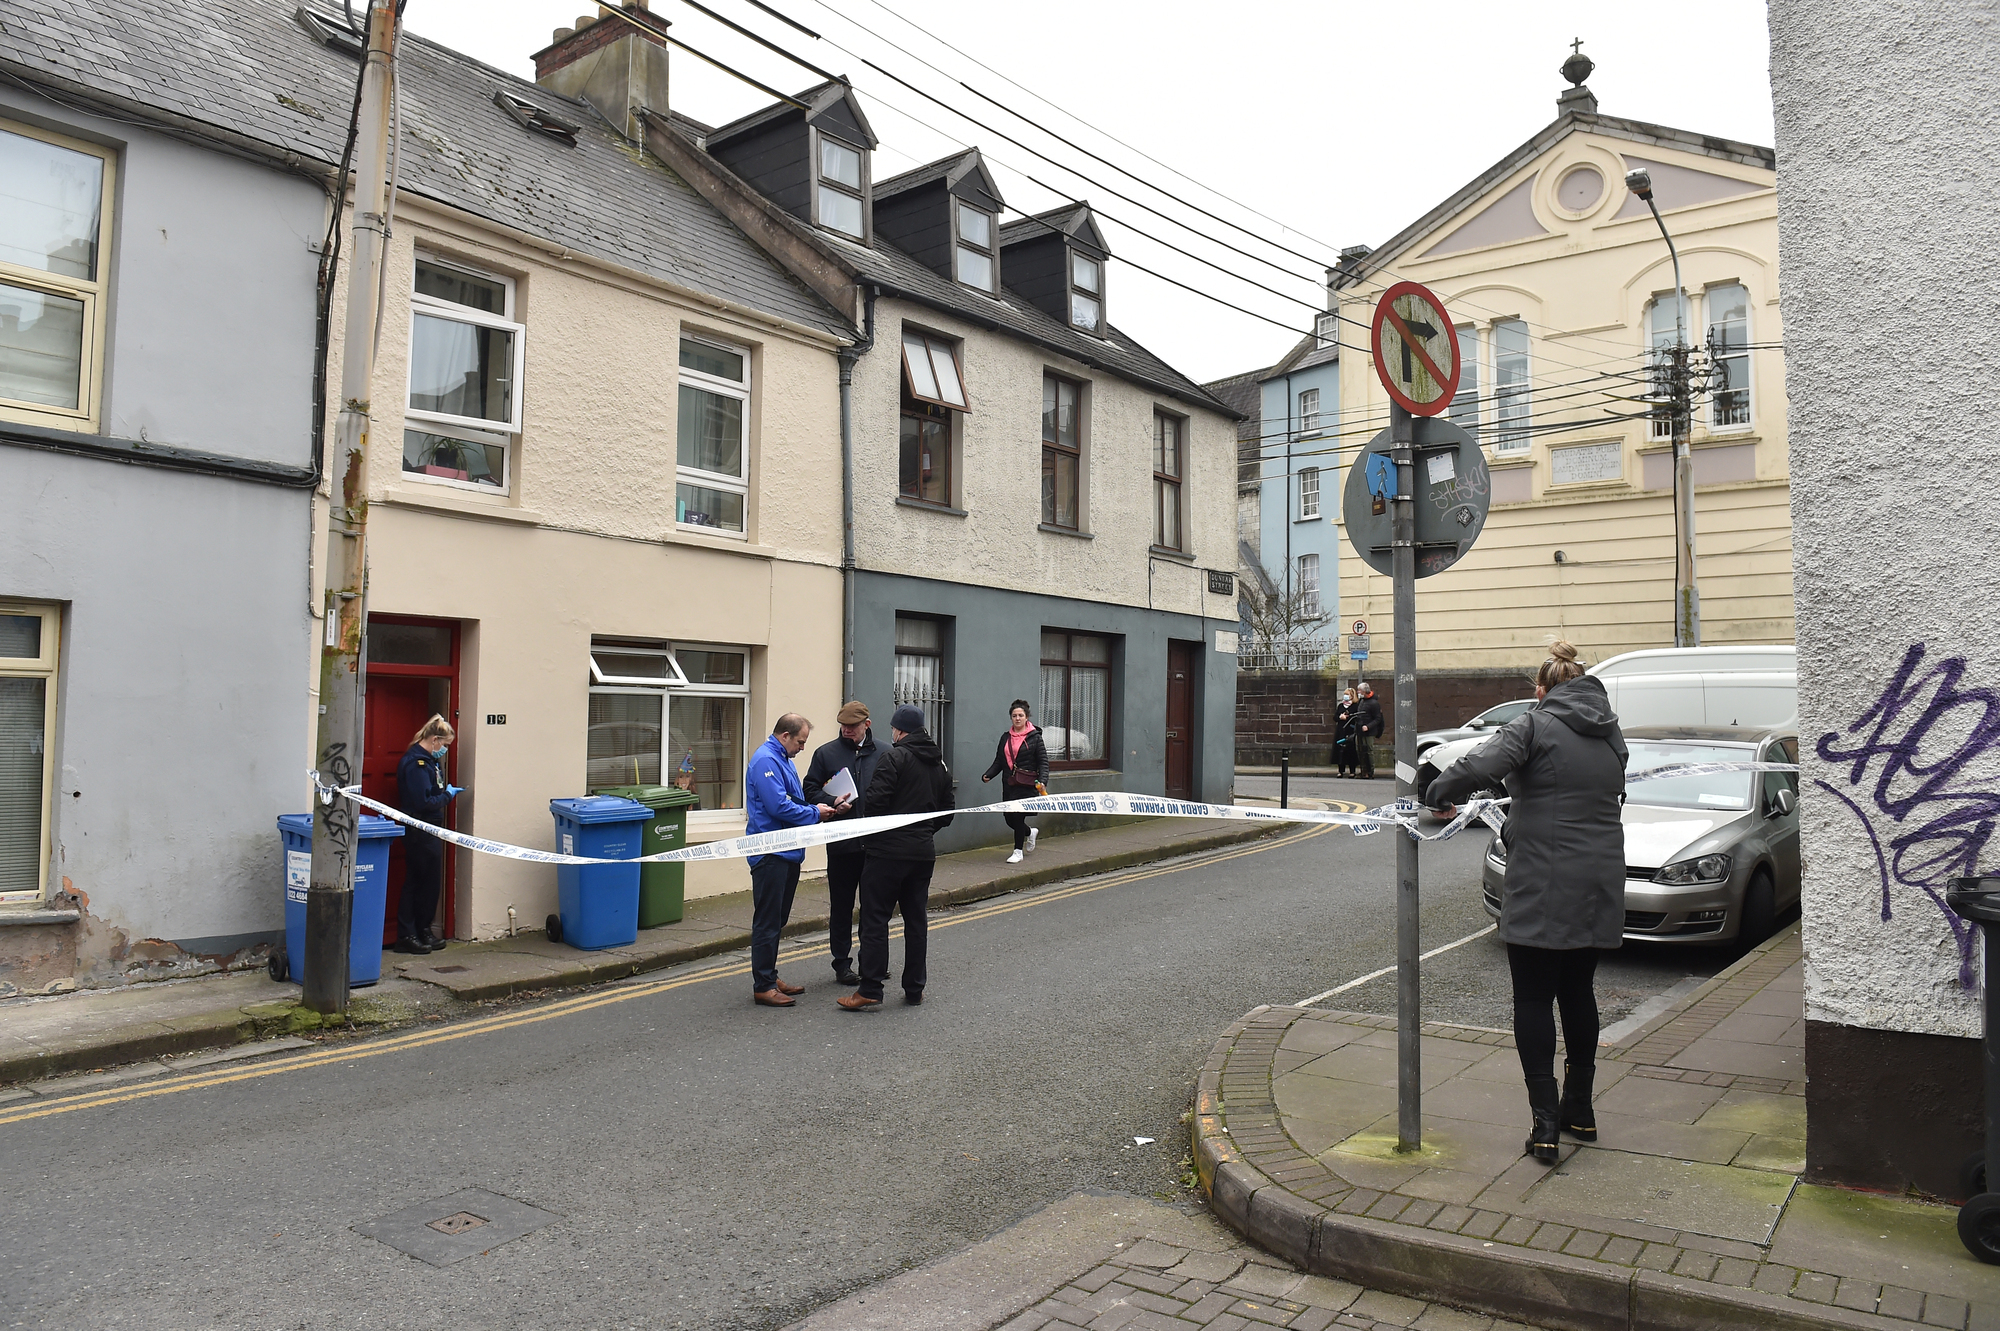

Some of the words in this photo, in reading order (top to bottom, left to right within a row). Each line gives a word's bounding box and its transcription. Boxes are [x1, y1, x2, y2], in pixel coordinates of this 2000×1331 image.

[1554, 448, 1592, 458] LAUDATE
[1596, 445, 1620, 454] PUERI
[1212, 582, 1231, 591] STREET
[1021, 802, 1057, 811] PARKING
[1058, 802, 1069, 811] NO
[1070, 801, 1097, 812] GARDA
[1130, 802, 1165, 814] PARKING
[1167, 804, 1179, 814] NO
[1180, 804, 1208, 815] GARDA
